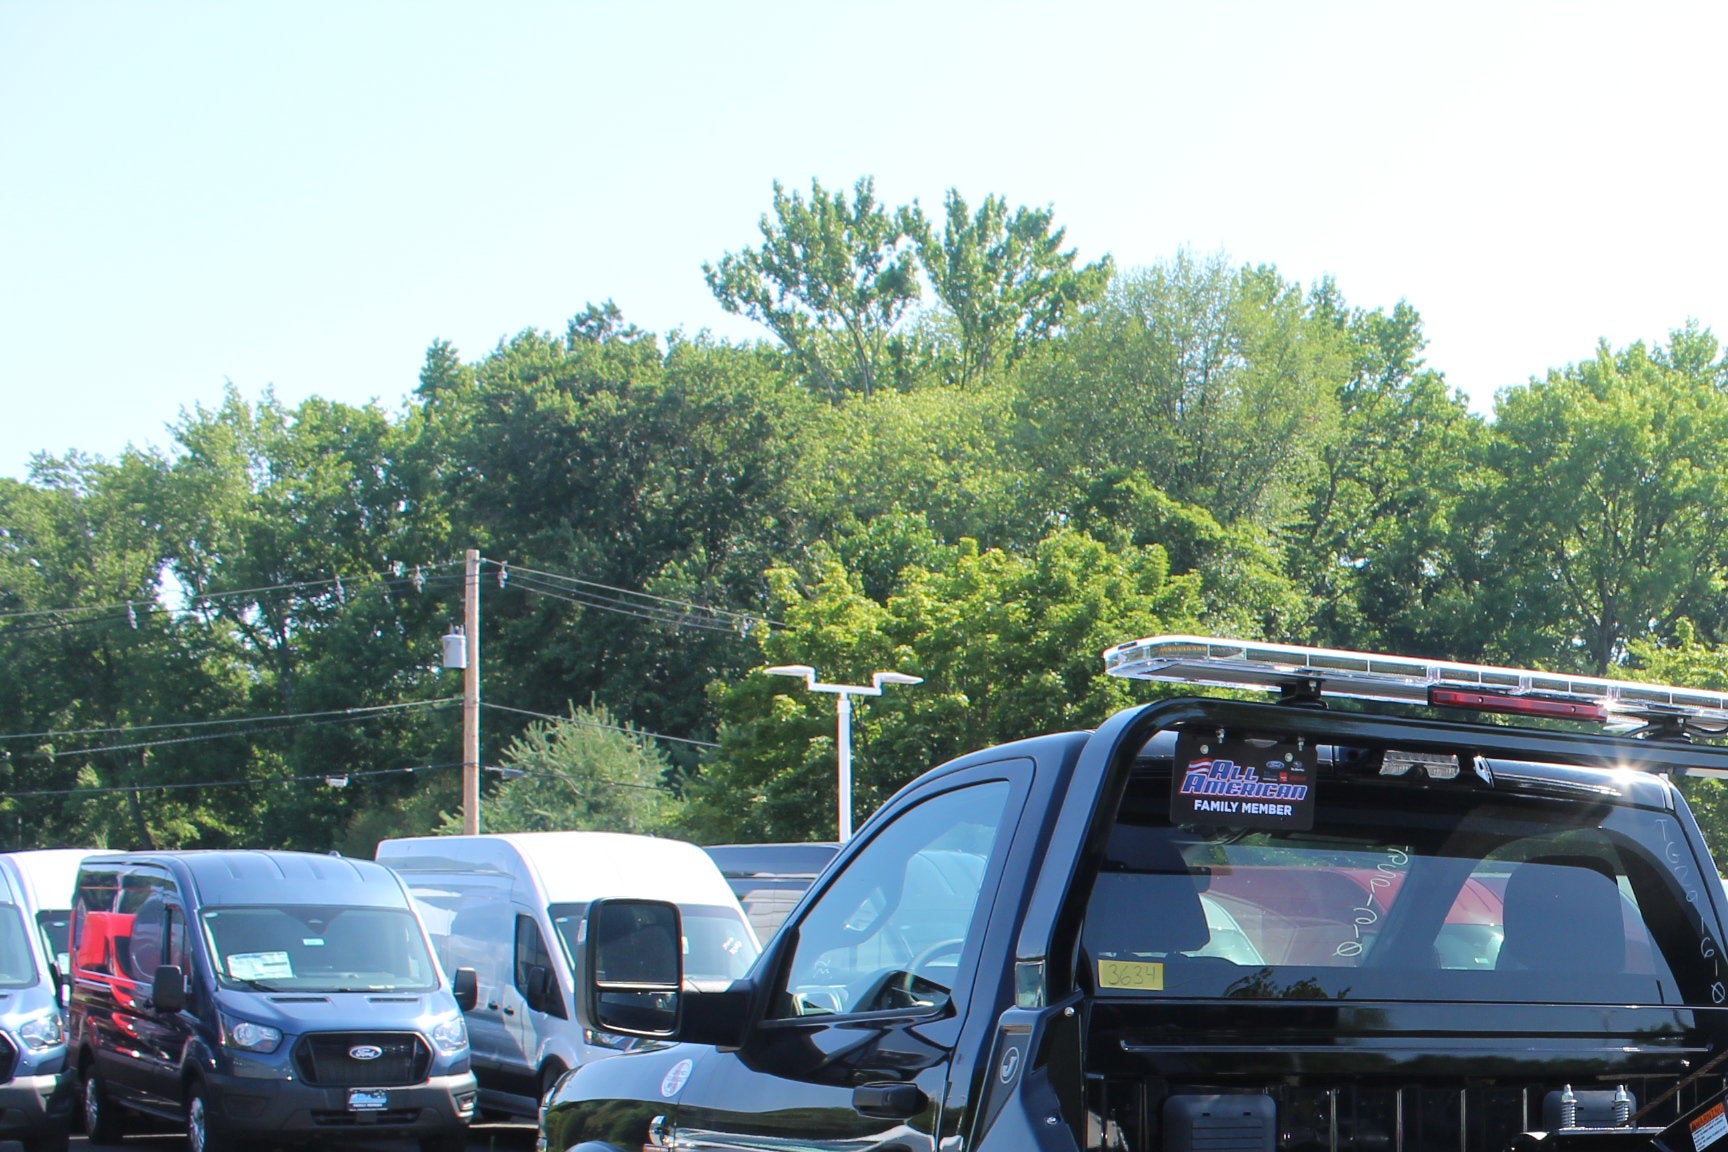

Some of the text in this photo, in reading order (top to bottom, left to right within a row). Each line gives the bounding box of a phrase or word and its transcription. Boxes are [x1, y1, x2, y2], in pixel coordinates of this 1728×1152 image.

[1208, 759, 1260, 782] ALL
[1181, 773, 1308, 801] AMERICAN
[1194, 800, 1292, 816] FAMILY MEMBER
[1108, 963, 1156, 985] 3634
[352, 1047, 380, 1059] Ford
